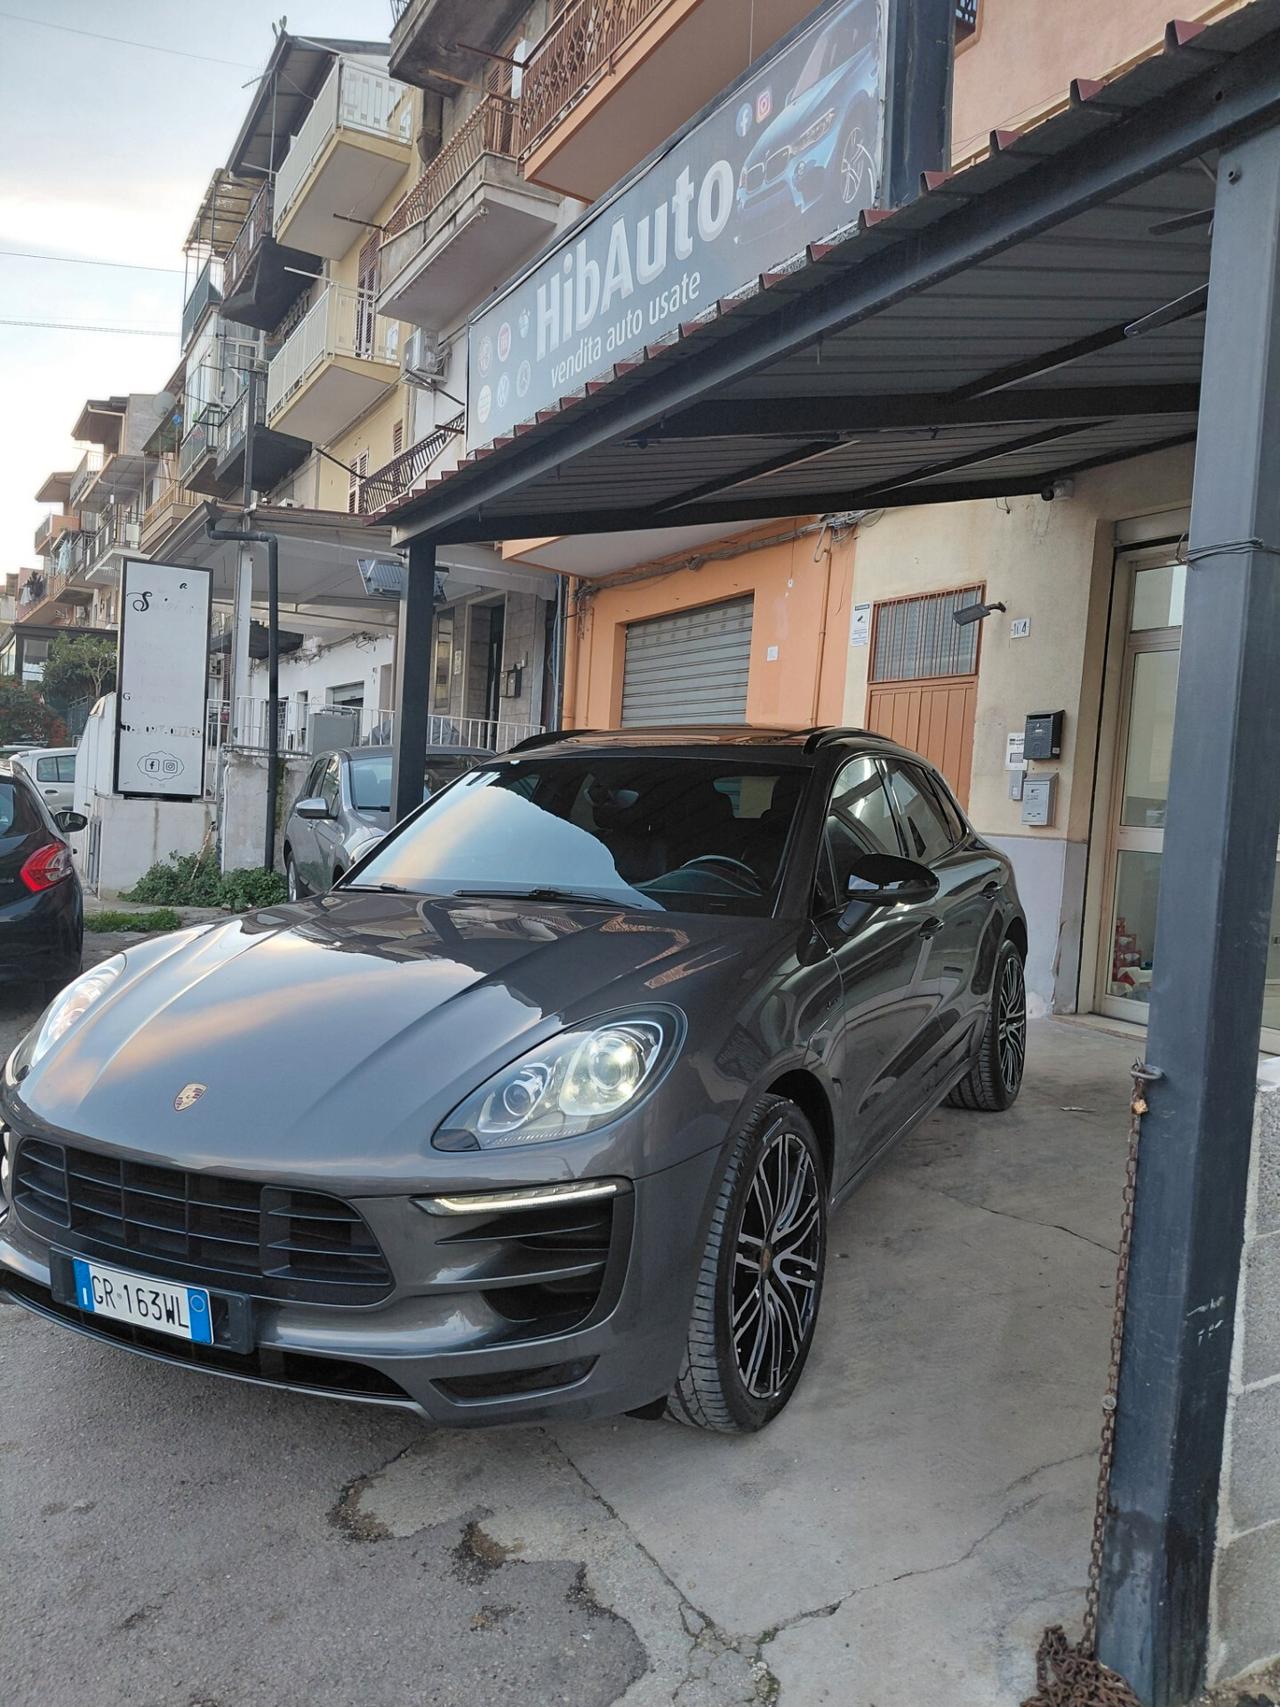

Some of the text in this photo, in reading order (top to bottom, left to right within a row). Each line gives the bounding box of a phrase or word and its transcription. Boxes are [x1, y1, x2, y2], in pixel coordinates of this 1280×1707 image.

[536, 159, 734, 362] HibAuto
[551, 336, 601, 389] vendita
[606, 308, 643, 352] auto
[649, 271, 701, 326] usate
[91, 1275, 190, 1329] GR 163WL
